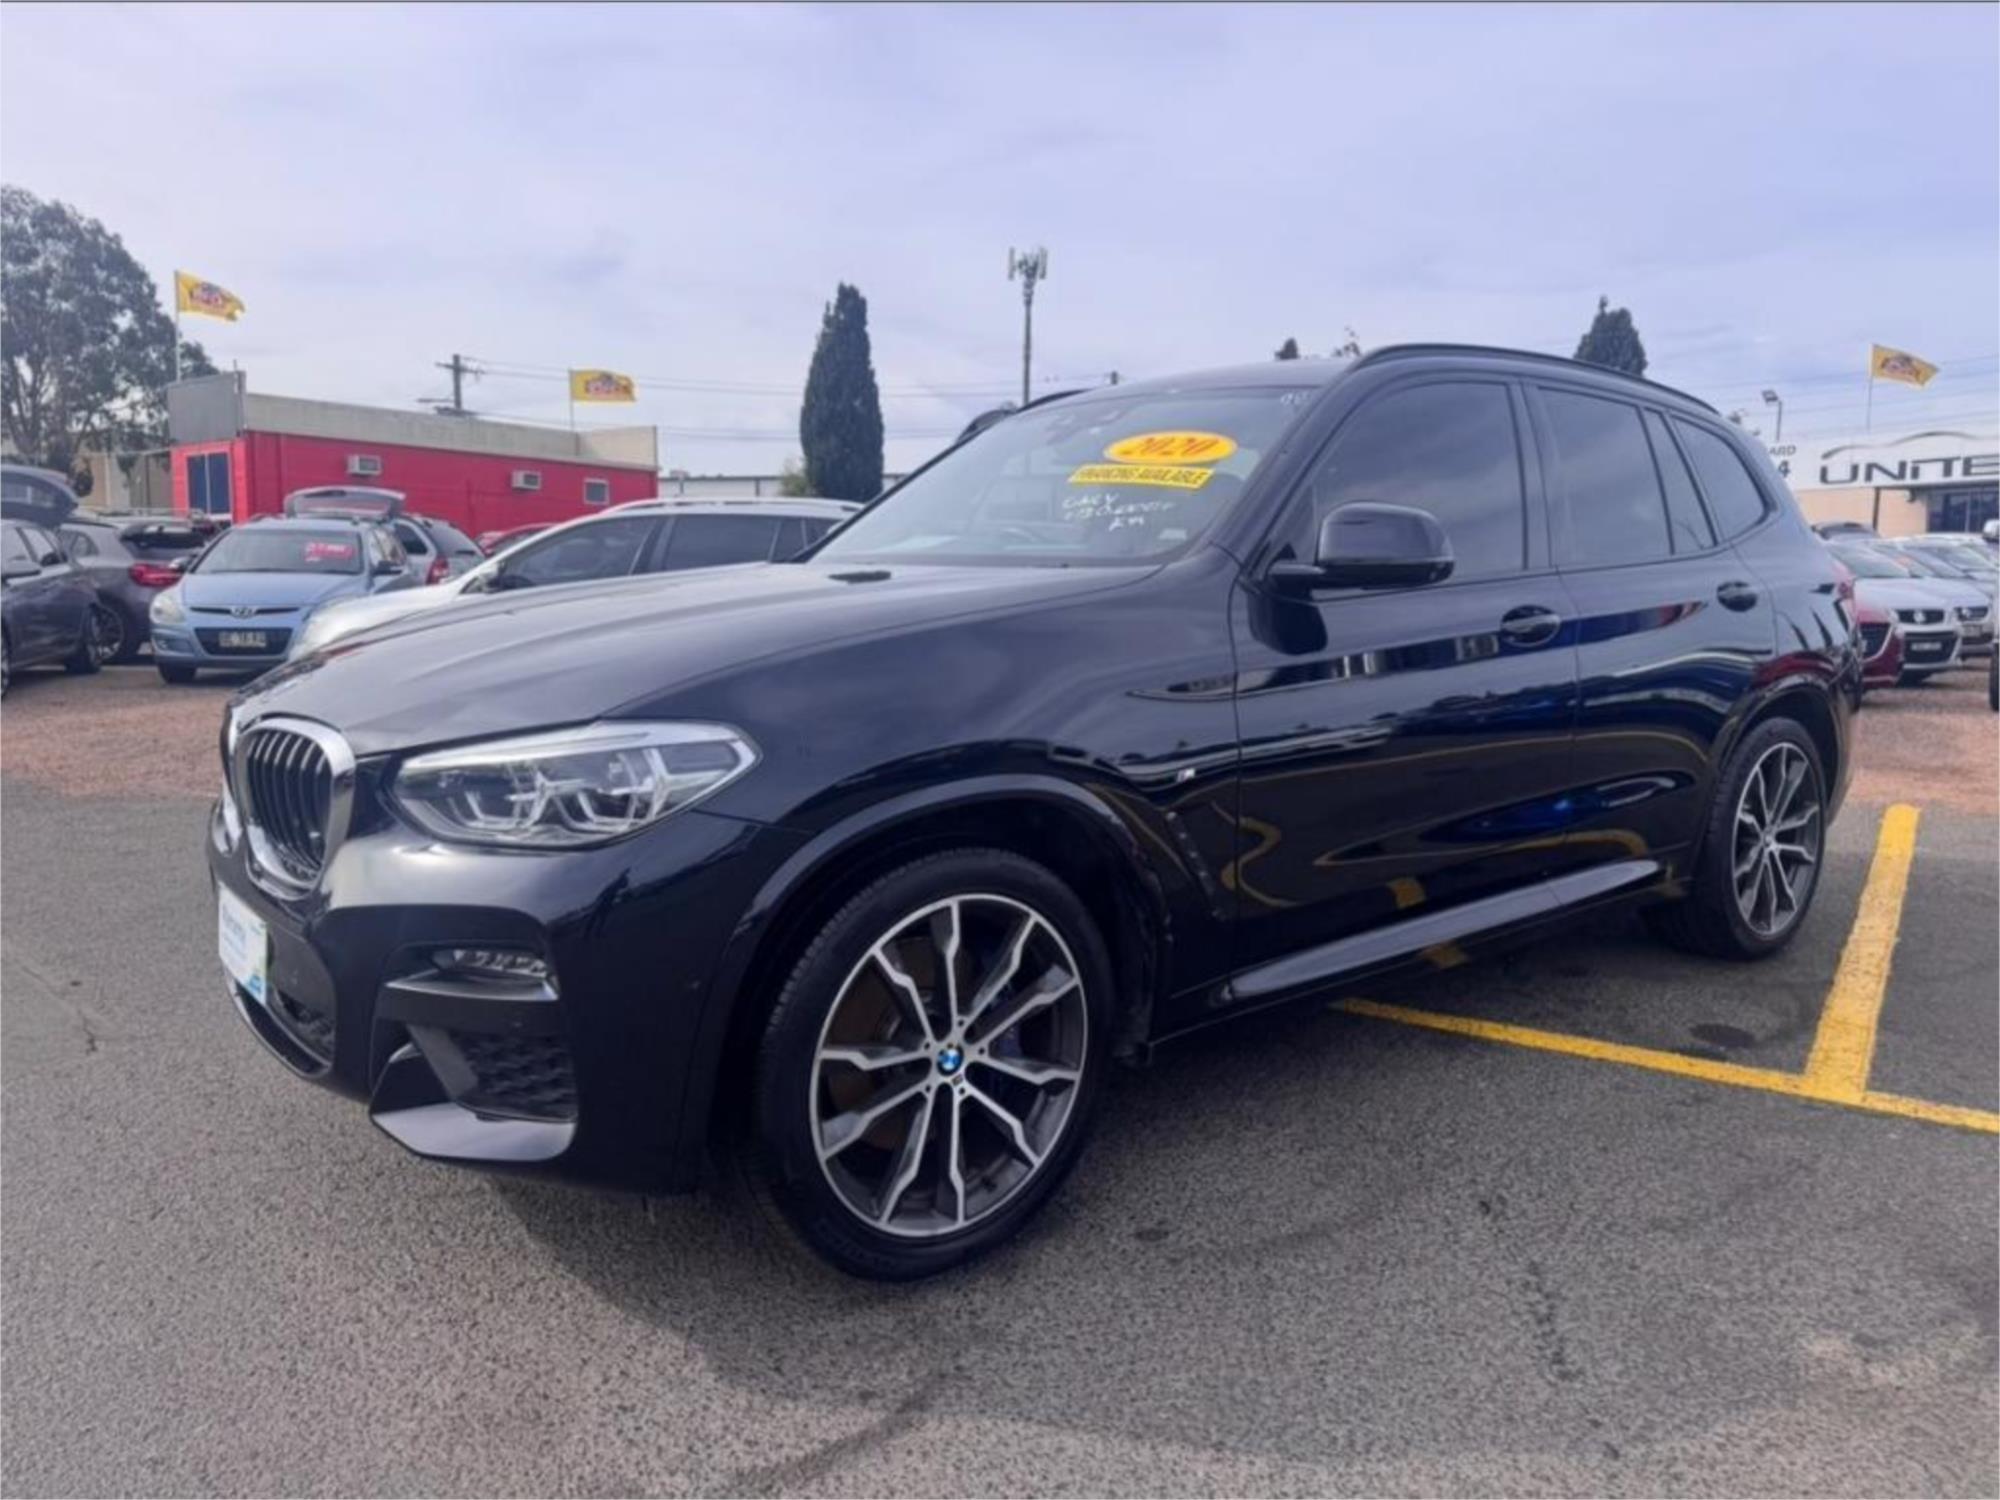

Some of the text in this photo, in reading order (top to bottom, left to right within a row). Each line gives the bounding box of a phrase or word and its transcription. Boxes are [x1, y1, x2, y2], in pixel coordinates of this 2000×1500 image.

[1120, 437, 1219, 456] 2020
[1137, 467, 1208, 485] AVAILABLE
[1819, 453, 2000, 485] UNITE
